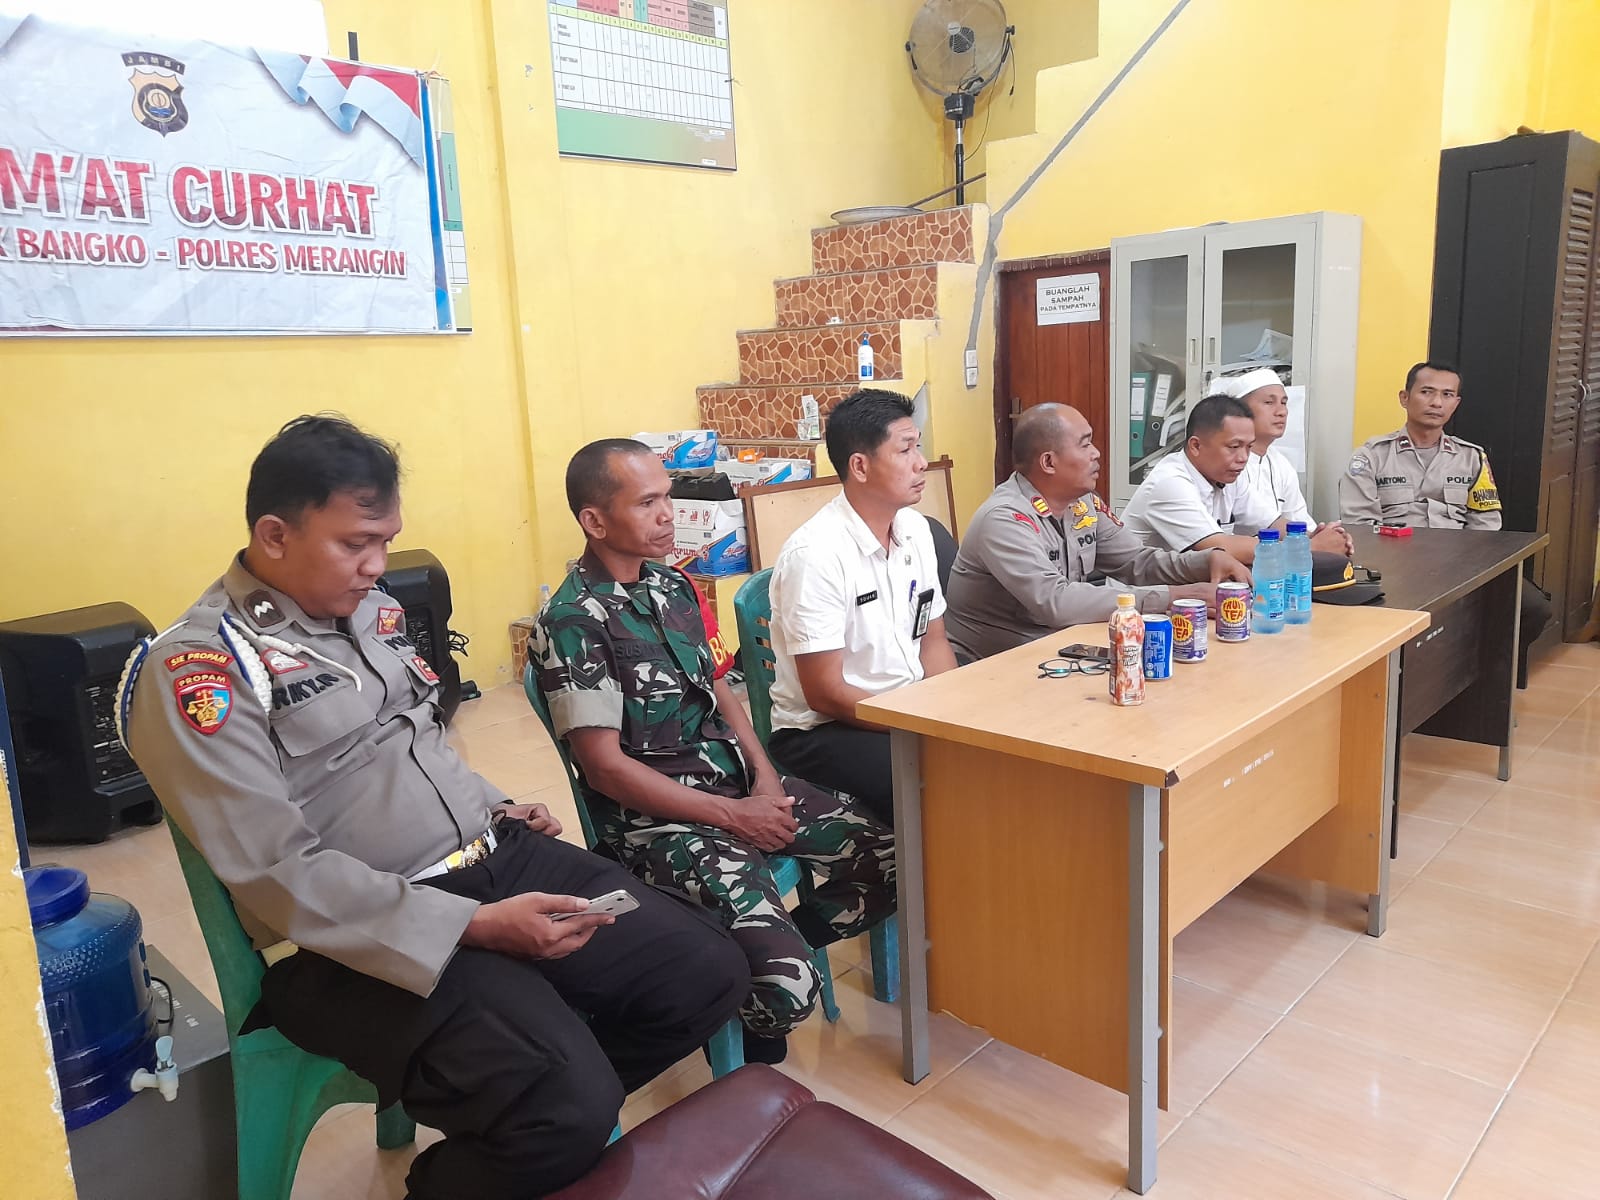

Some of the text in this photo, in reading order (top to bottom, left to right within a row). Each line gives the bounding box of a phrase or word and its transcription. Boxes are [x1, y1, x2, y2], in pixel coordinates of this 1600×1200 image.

[127, 55, 181, 71] JAMBI
[172, 166, 375, 235] CURHAT
[16, 228, 146, 264] BANGKO
[178, 238, 276, 269] POLRES
[284, 244, 405, 276] MERANGIN
[1046, 286, 1090, 296] BUANGLAH
[1051, 295, 1084, 304] SAMPAH
[1059, 302, 1096, 311] TEMPATNYA
[1223, 600, 1244, 611] FRUIT
[1224, 609, 1243, 620] TEA
[170, 652, 228, 666] SIE PROPAM
[178, 674, 226, 687] PROPAM
